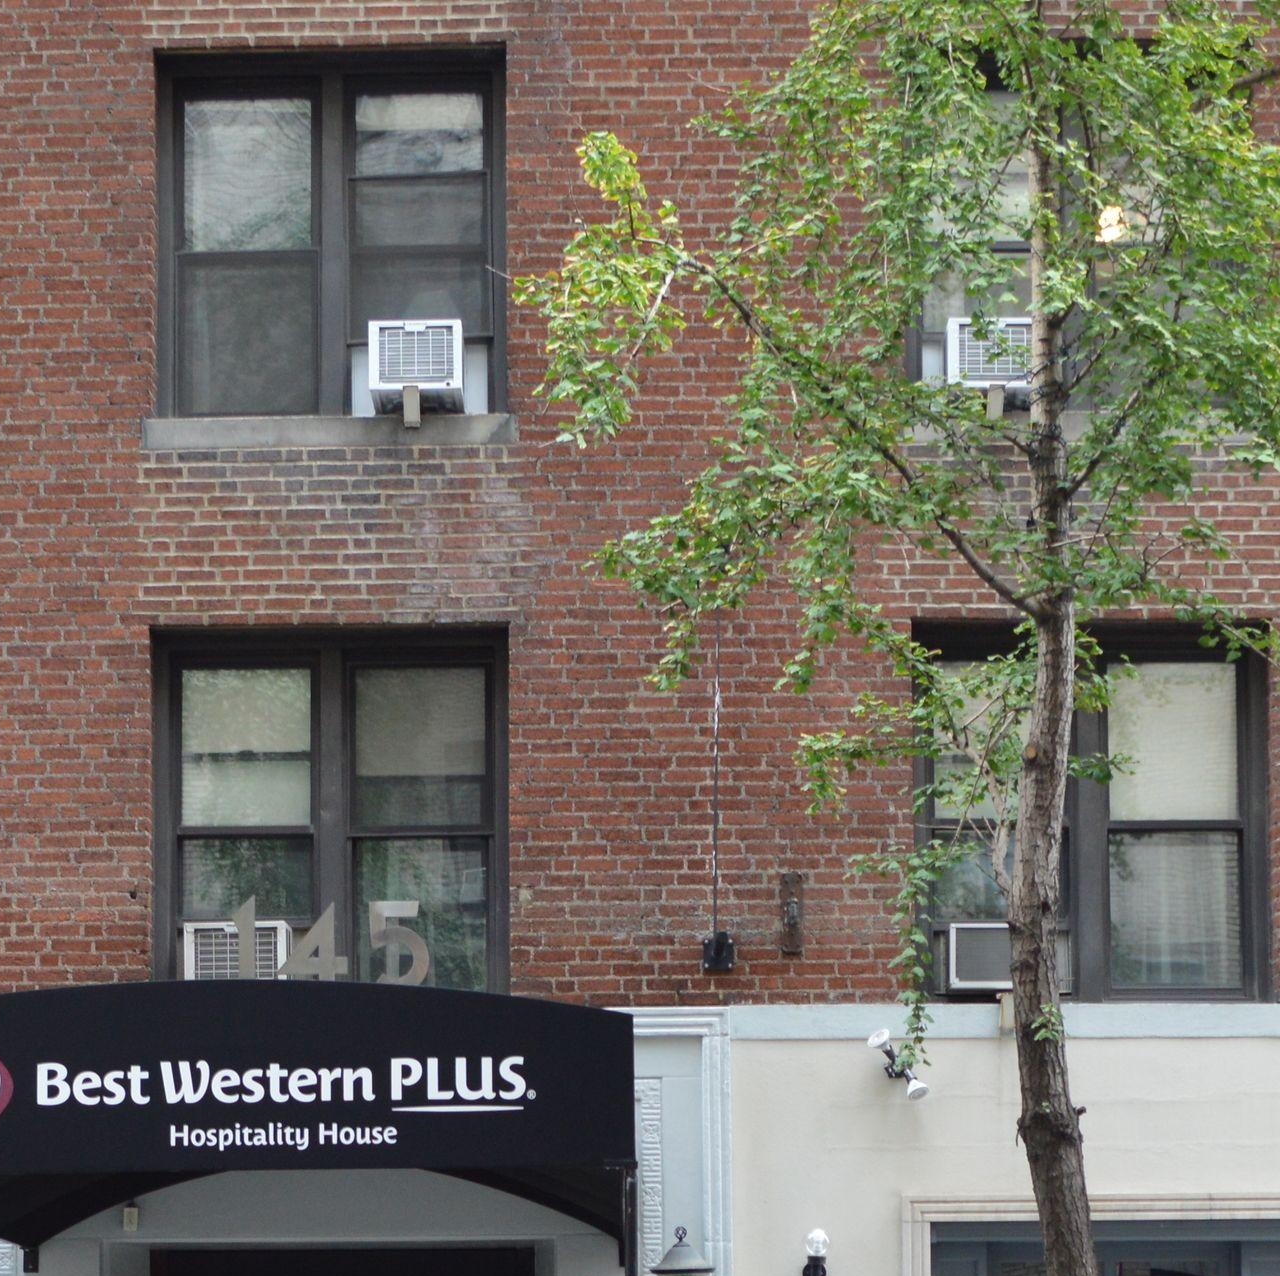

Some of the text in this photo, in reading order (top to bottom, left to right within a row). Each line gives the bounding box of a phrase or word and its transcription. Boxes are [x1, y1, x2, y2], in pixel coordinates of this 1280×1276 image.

[232, 894, 430, 987] 145
[35, 1060, 151, 1107] Best
[160, 1059, 376, 1105] Western
[169, 1122, 398, 1151] Hospitality House
